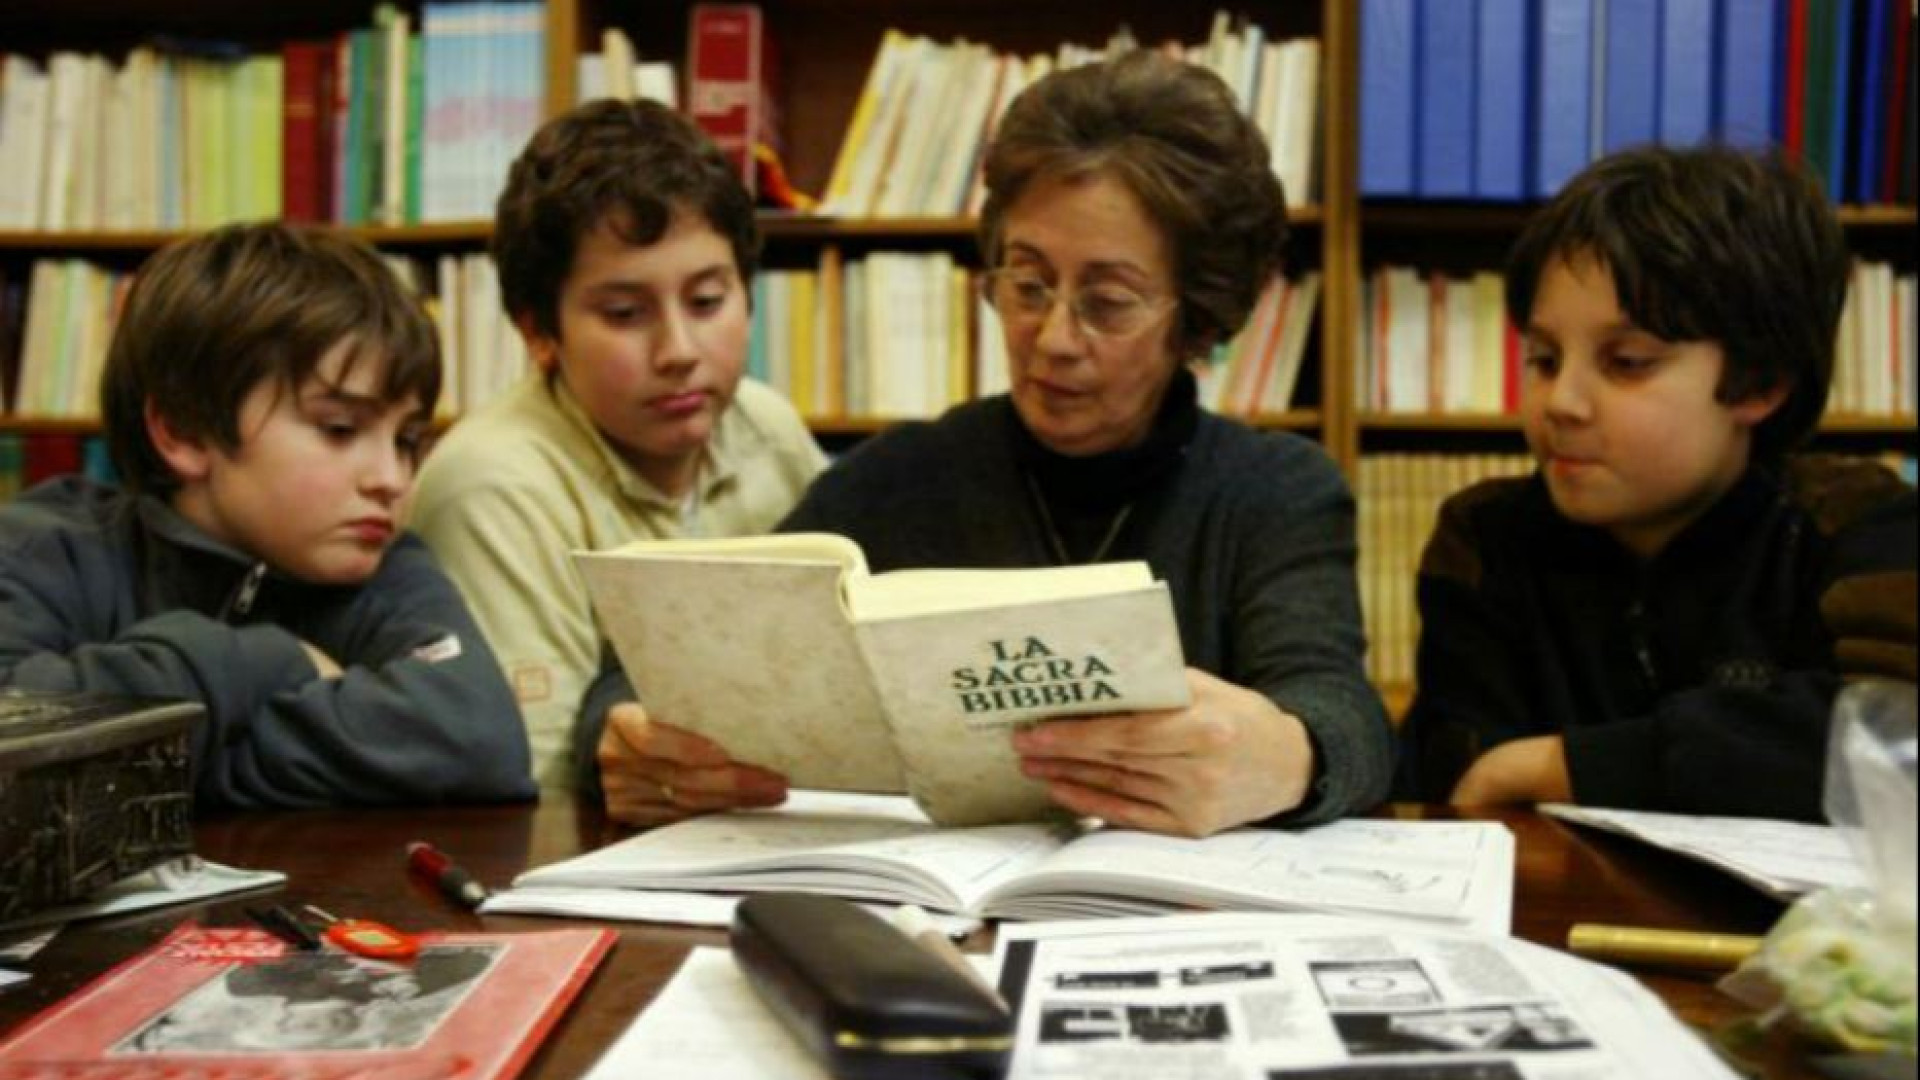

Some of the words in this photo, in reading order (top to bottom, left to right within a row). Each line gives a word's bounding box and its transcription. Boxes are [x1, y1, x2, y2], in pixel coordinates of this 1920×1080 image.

[989, 635, 1053, 661] LA
[952, 655, 1113, 690] SACRA
[960, 680, 1121, 713] BIBBIA
